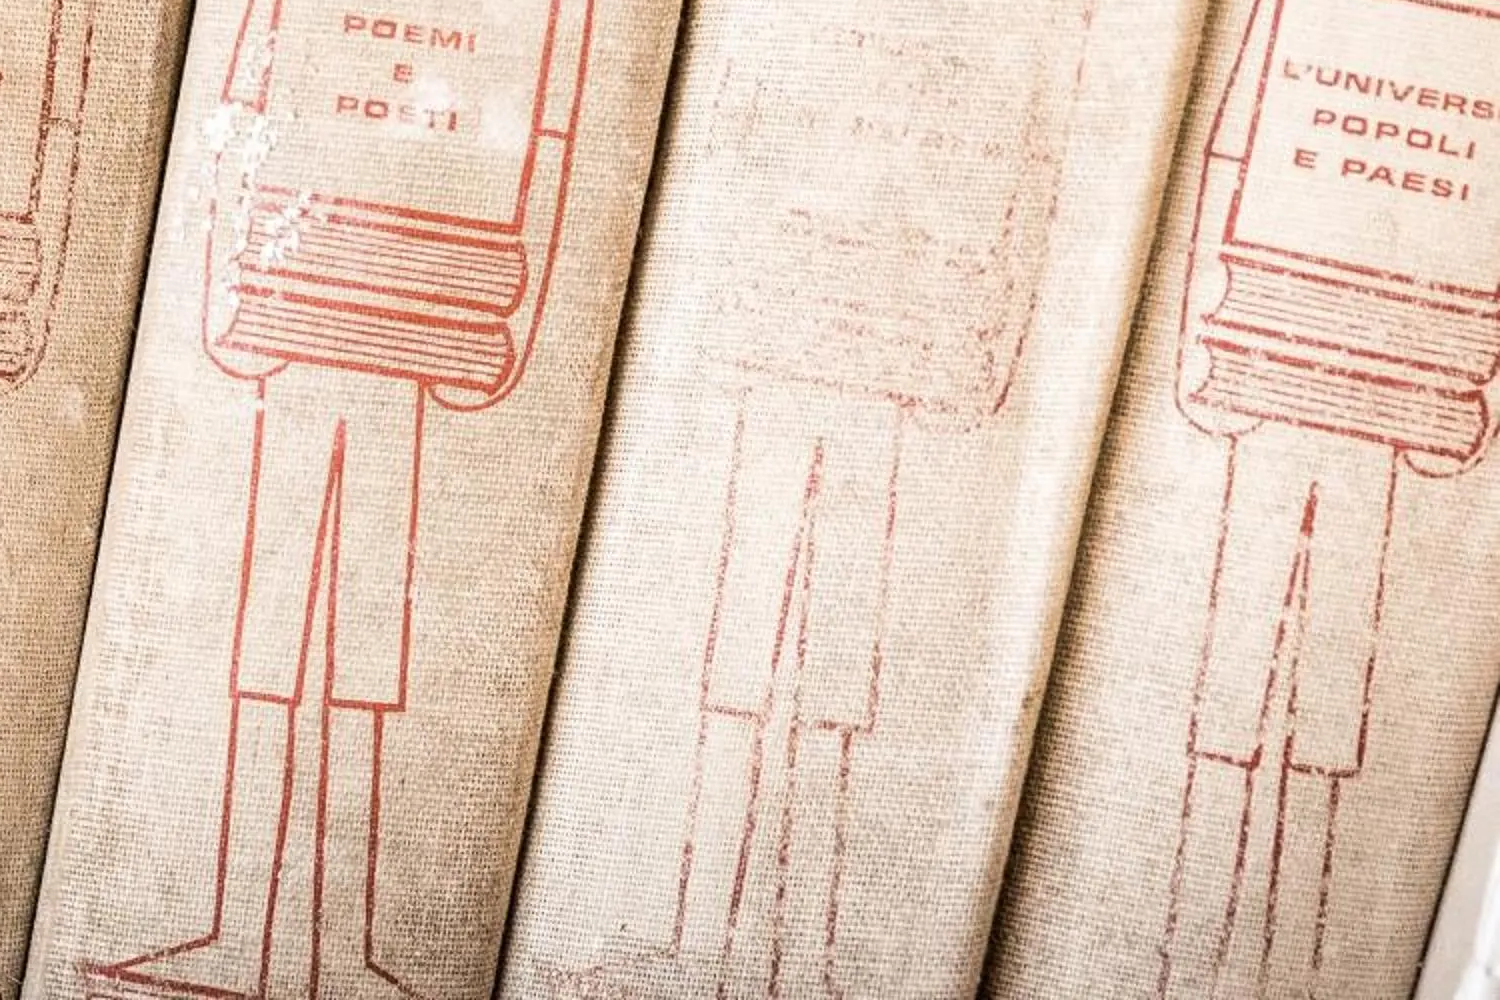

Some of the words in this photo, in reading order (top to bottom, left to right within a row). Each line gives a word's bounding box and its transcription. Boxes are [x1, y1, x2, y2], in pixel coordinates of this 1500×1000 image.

[343, 14, 477, 53] POEMI
[393, 63, 414, 84] E
[1283, 59, 1500, 124] L'UNIVERS
[336, 94, 458, 132] POETI
[1313, 107, 1477, 160] POPOLI
[1293, 148, 1318, 170] E
[1340, 157, 1470, 202] PAESI
